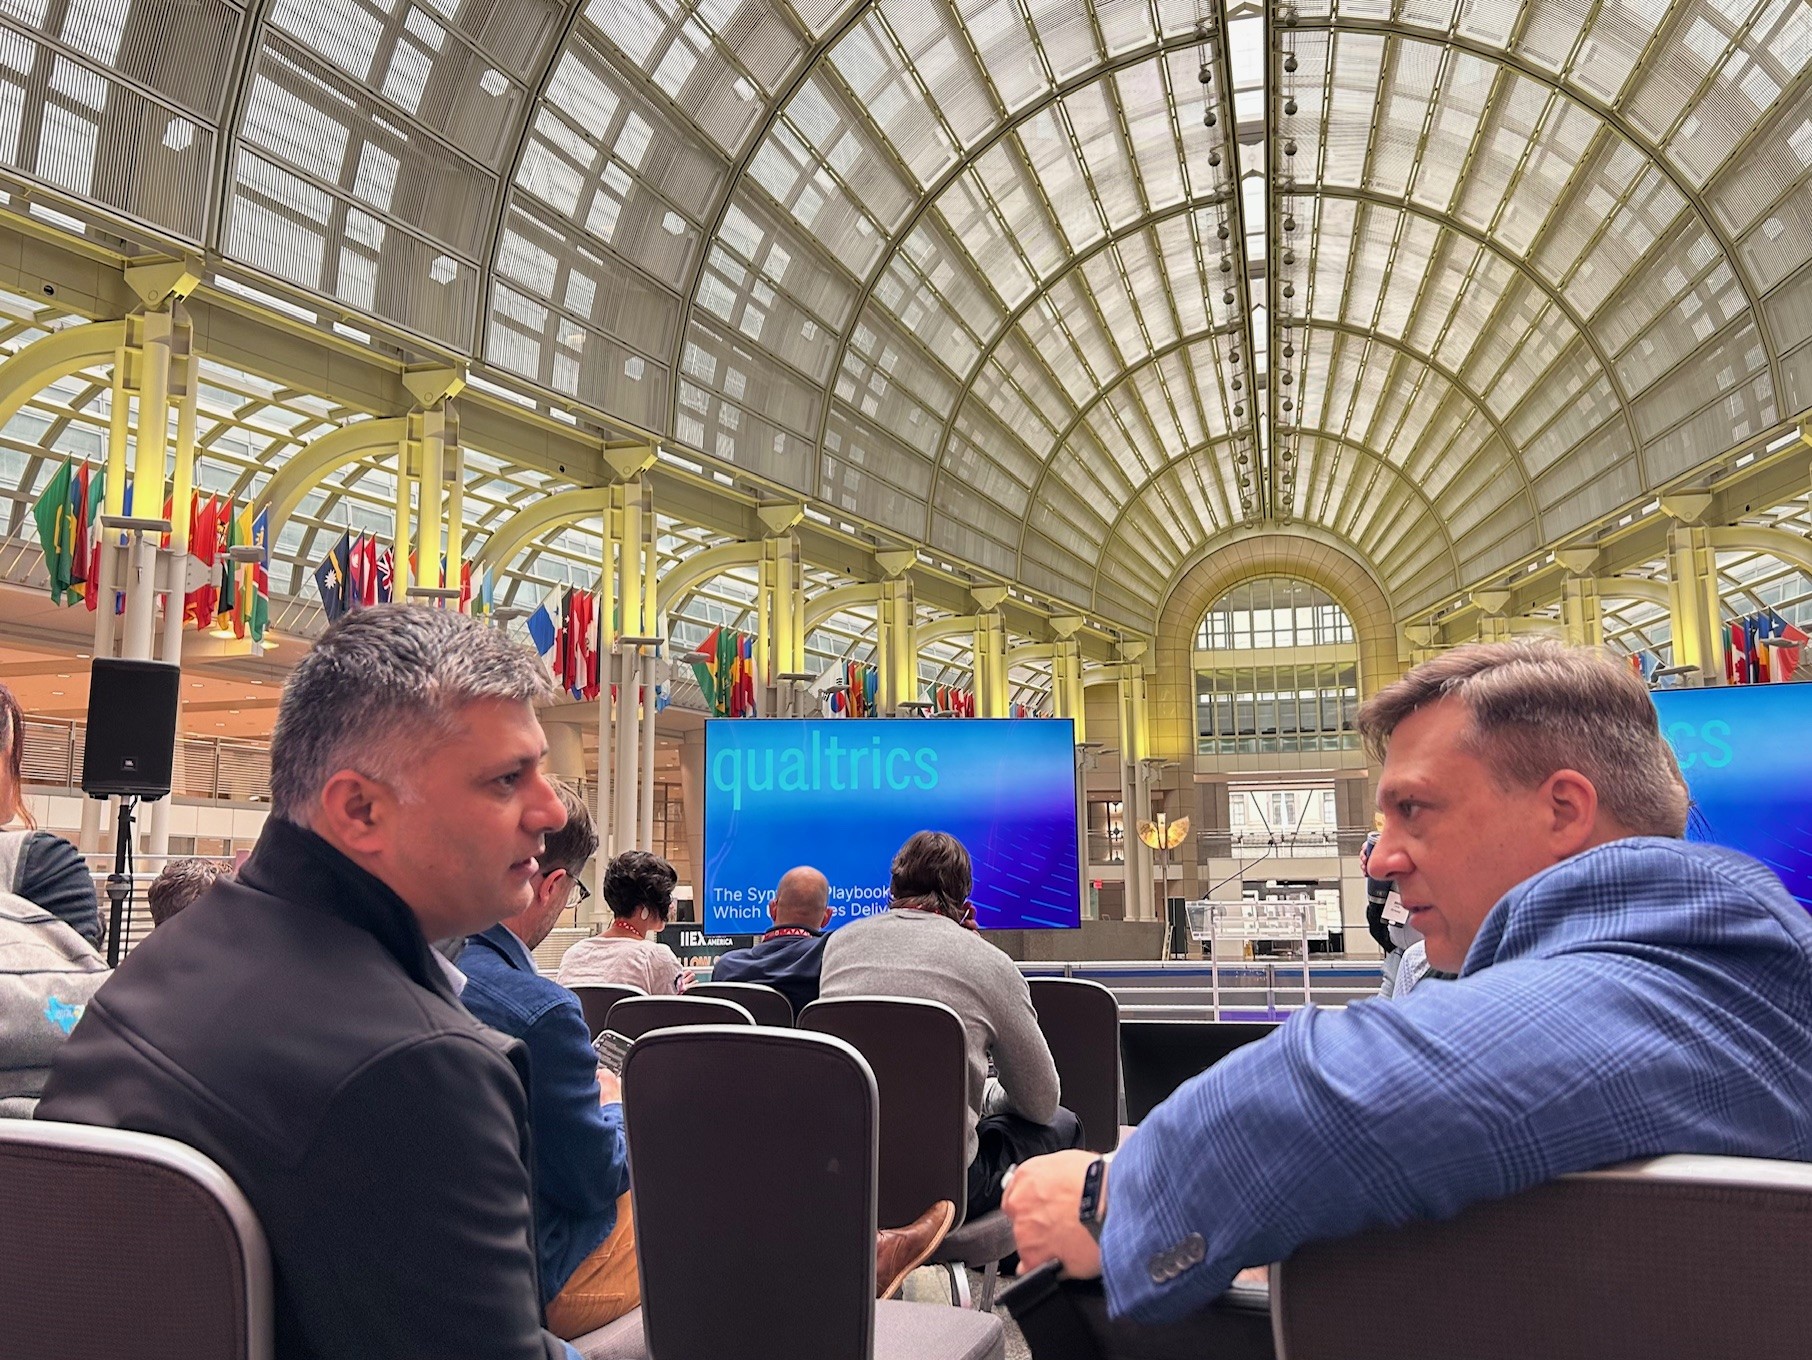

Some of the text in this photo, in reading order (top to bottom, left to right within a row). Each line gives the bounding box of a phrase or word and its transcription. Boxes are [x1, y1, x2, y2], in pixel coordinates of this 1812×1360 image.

[712, 730, 939, 811] qualtrics
[713, 888, 743, 902] The
[747, 887, 777, 904] Syn
[713, 905, 761, 919] Which
